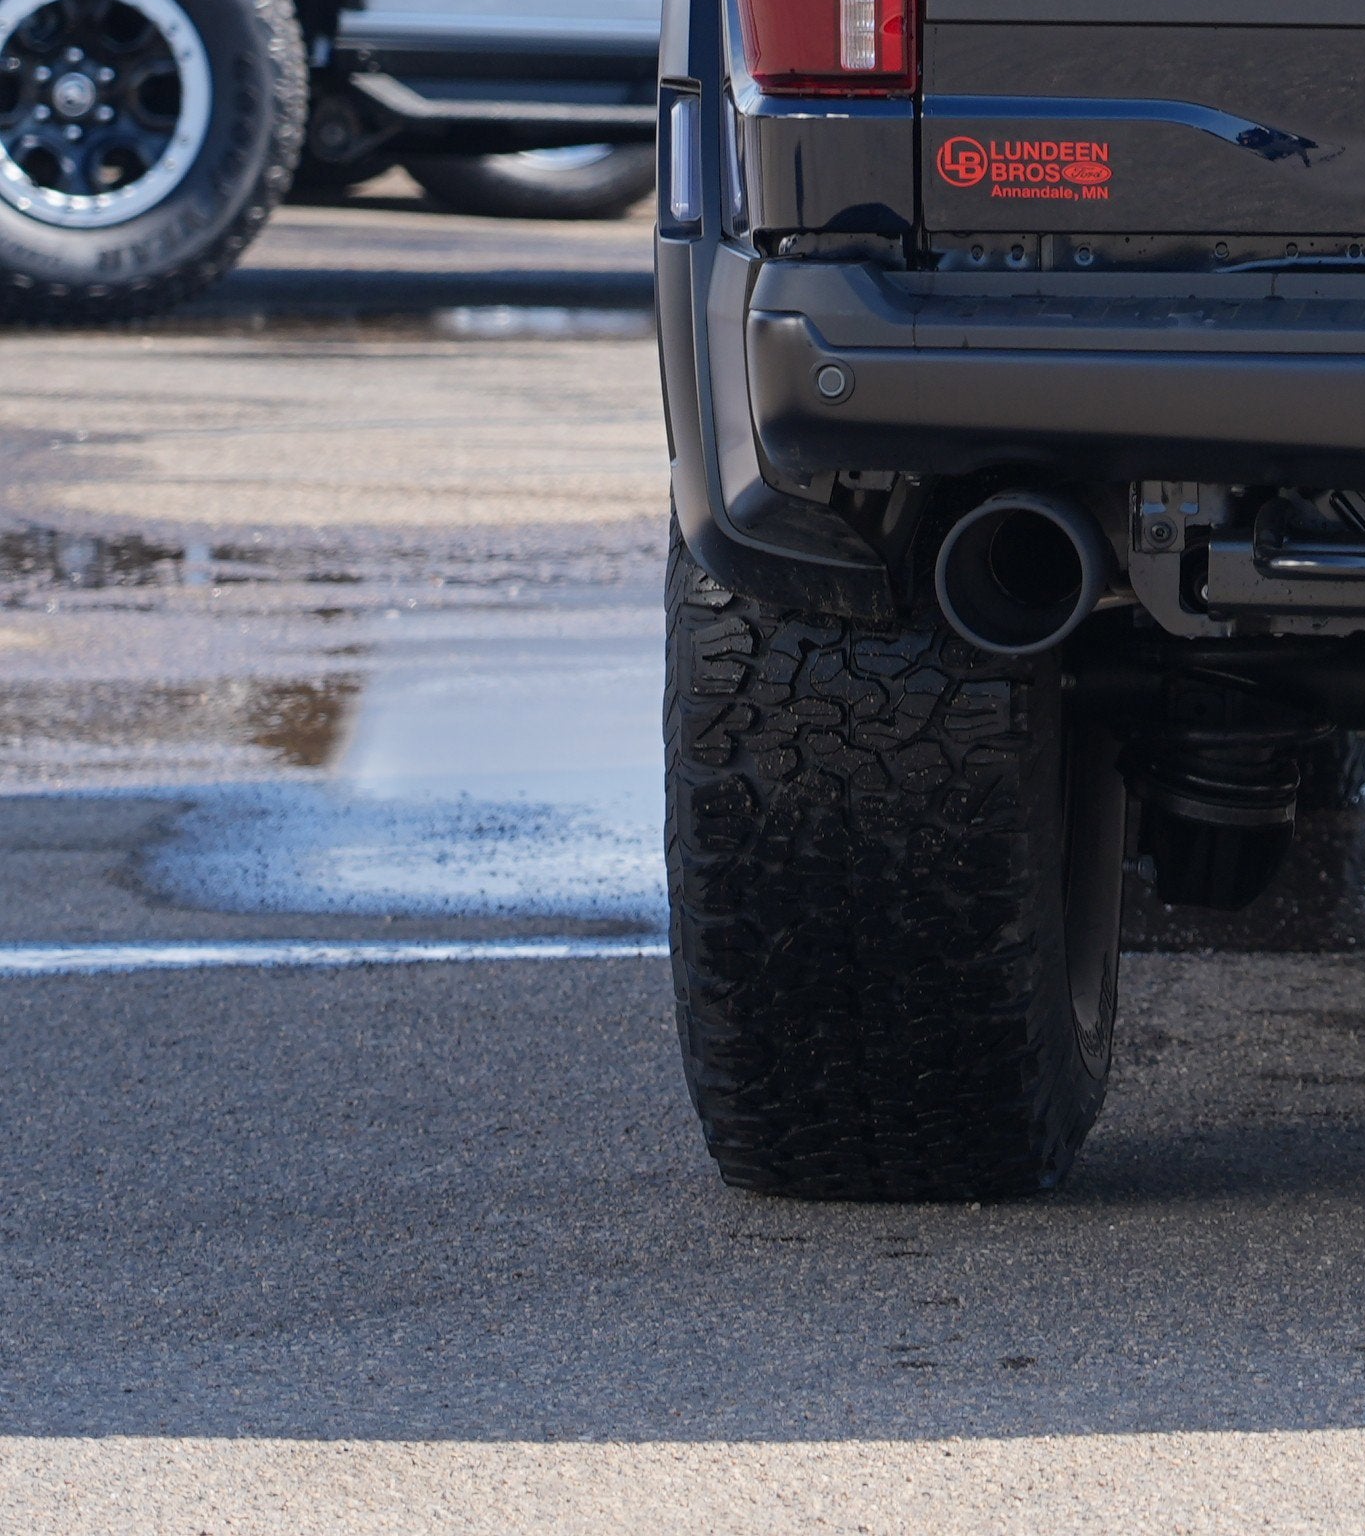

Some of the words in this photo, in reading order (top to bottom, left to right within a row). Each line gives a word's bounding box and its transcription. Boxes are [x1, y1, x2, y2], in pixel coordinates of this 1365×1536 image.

[990, 140, 1109, 161] LUNDEEN
[991, 163, 1062, 183] BROS
[1070, 166, 1102, 180] Ford
[991, 185, 1079, 201] Annandale,
[1082, 186, 1110, 199] MN
